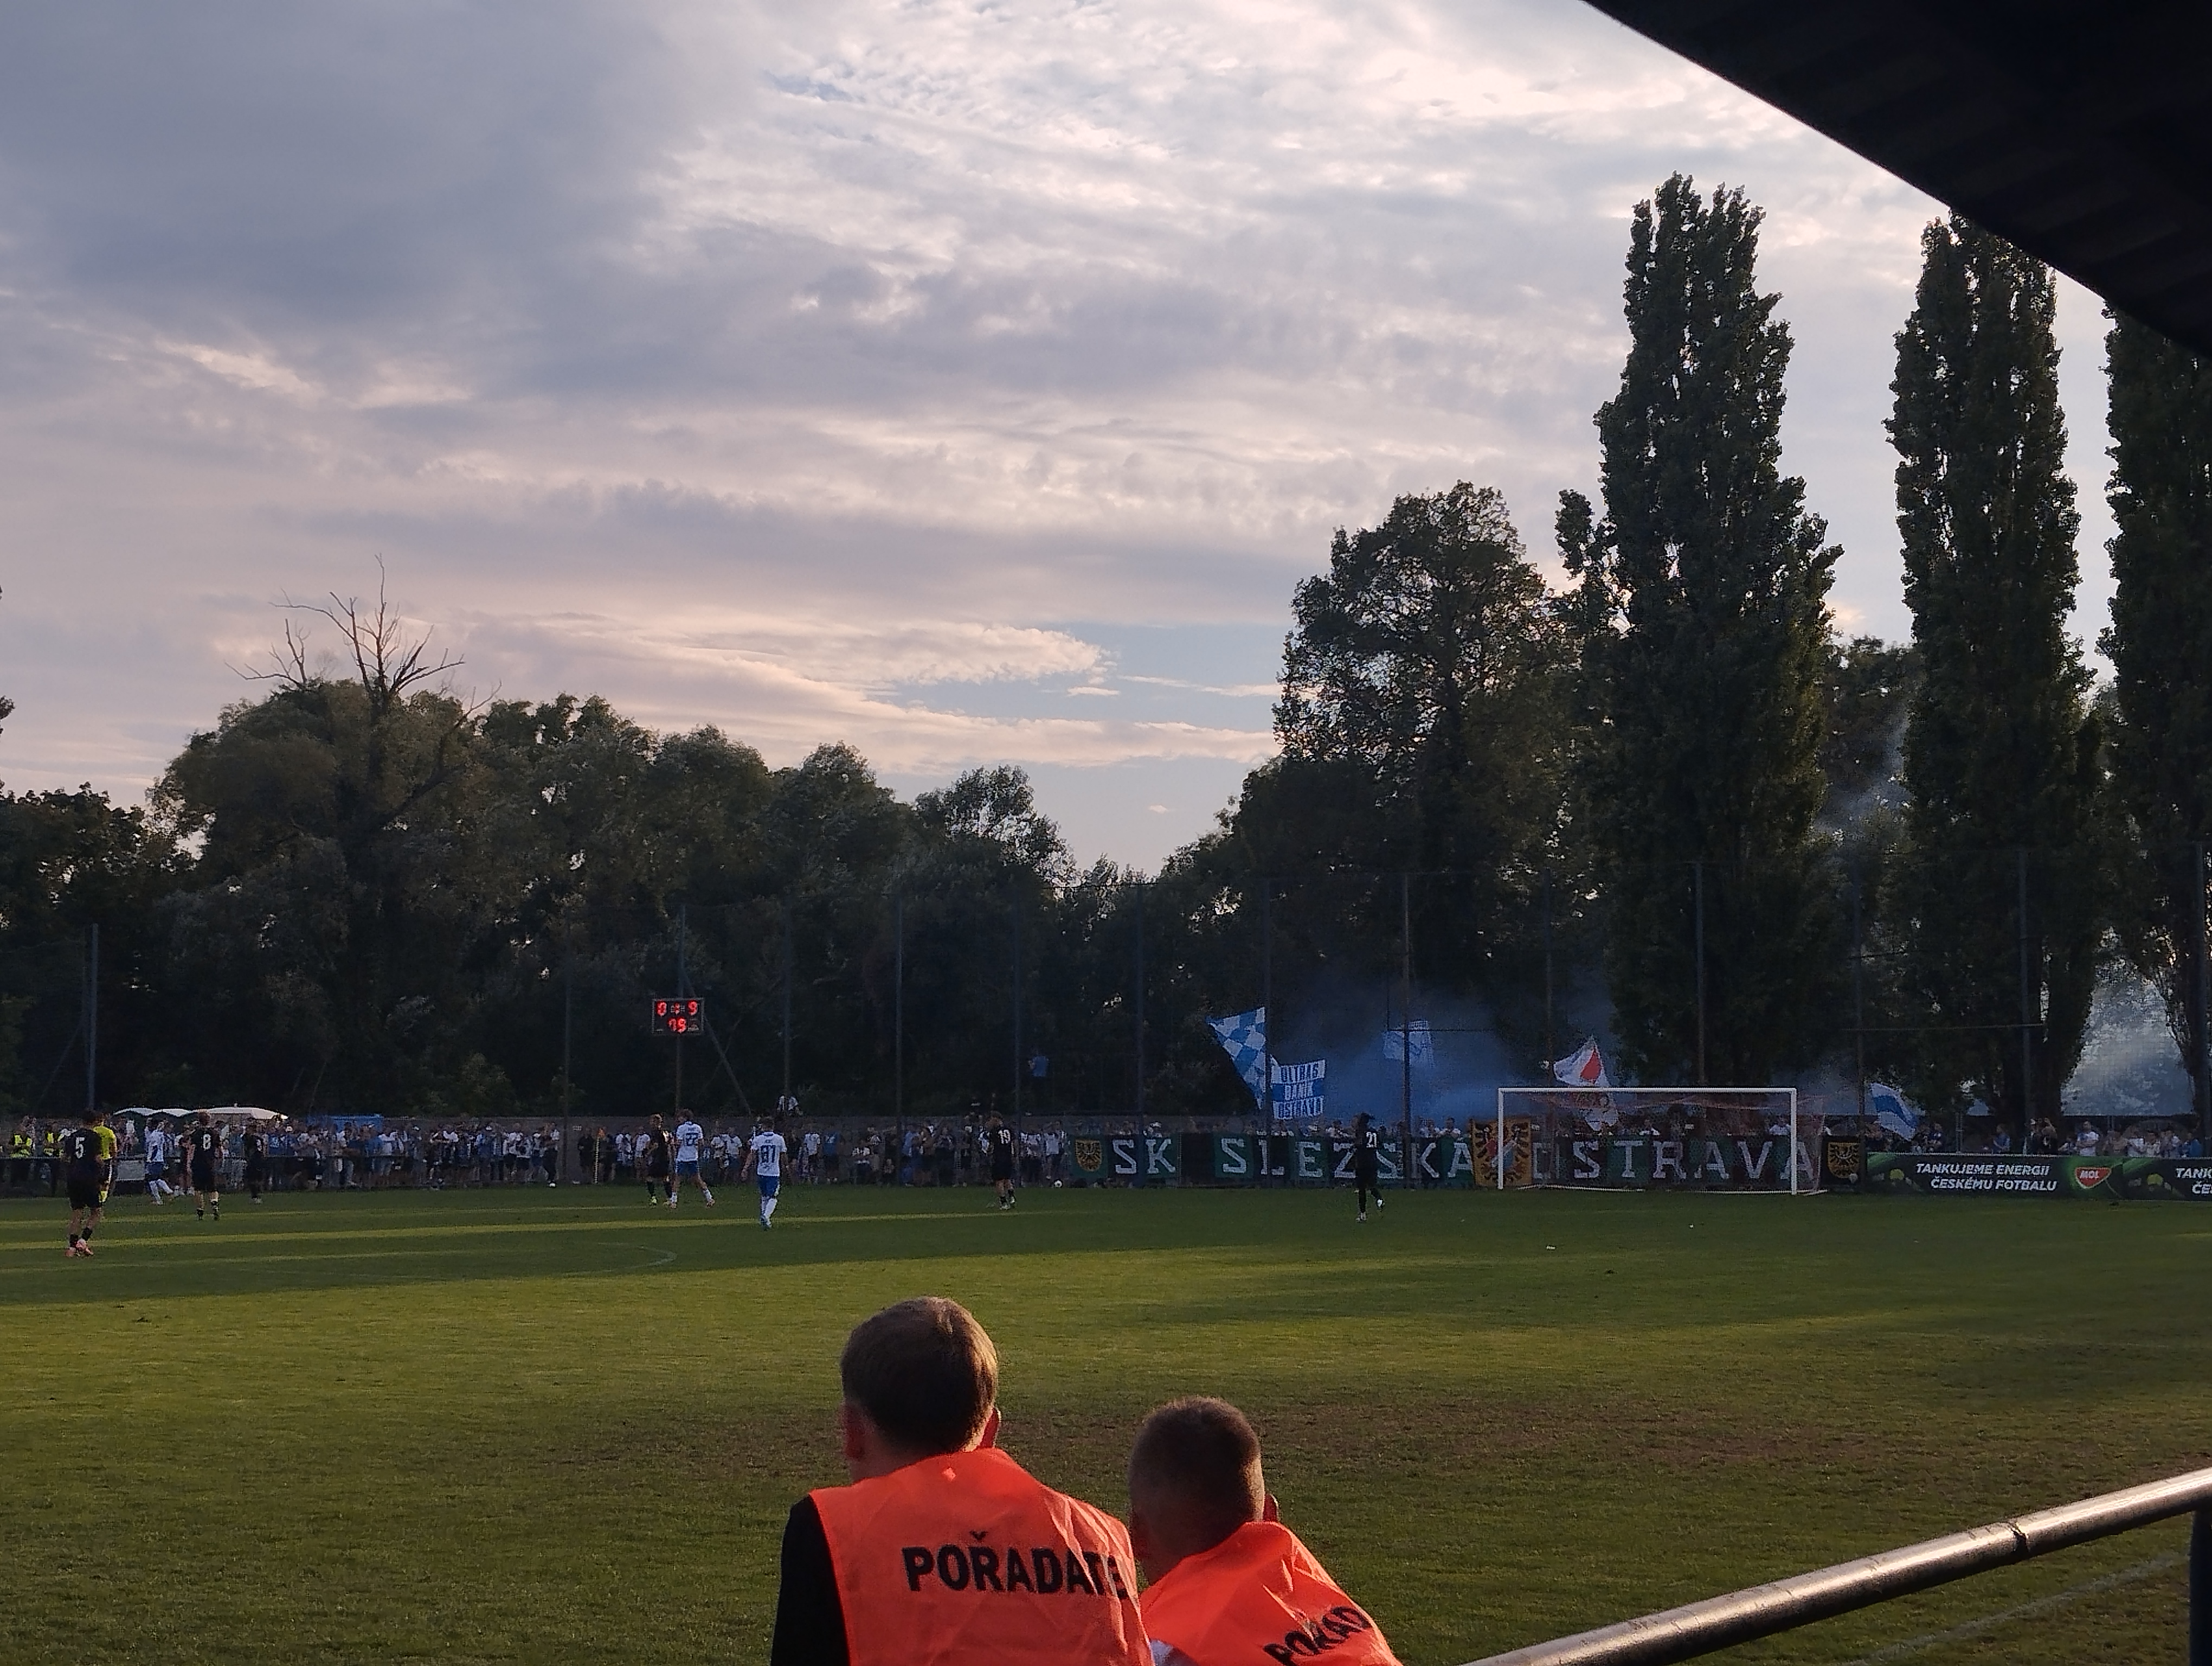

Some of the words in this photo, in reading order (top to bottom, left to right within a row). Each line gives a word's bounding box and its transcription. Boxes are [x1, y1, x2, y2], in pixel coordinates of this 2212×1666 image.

[1280, 1063, 1319, 1082] ULTRAS
[202, 1133, 212, 1150] 8
[998, 1129, 1011, 1145] 19
[1366, 1131, 1377, 1148] 21
[75, 1137, 86, 1159] 5
[1113, 1138, 1176, 1174] SK
[1532, 1140, 1815, 1180] OSTRAVA
[1915, 1163, 1996, 1175] TANKUJEME
[1996, 1165, 2051, 1176] ENERGII
[2080, 1170, 2099, 1180] MOL
[1930, 1175, 1994, 1190] ČESKÉMU
[1995, 1180, 2057, 1191] FOTBALU
[2191, 1180, 2212, 1195] ČE
